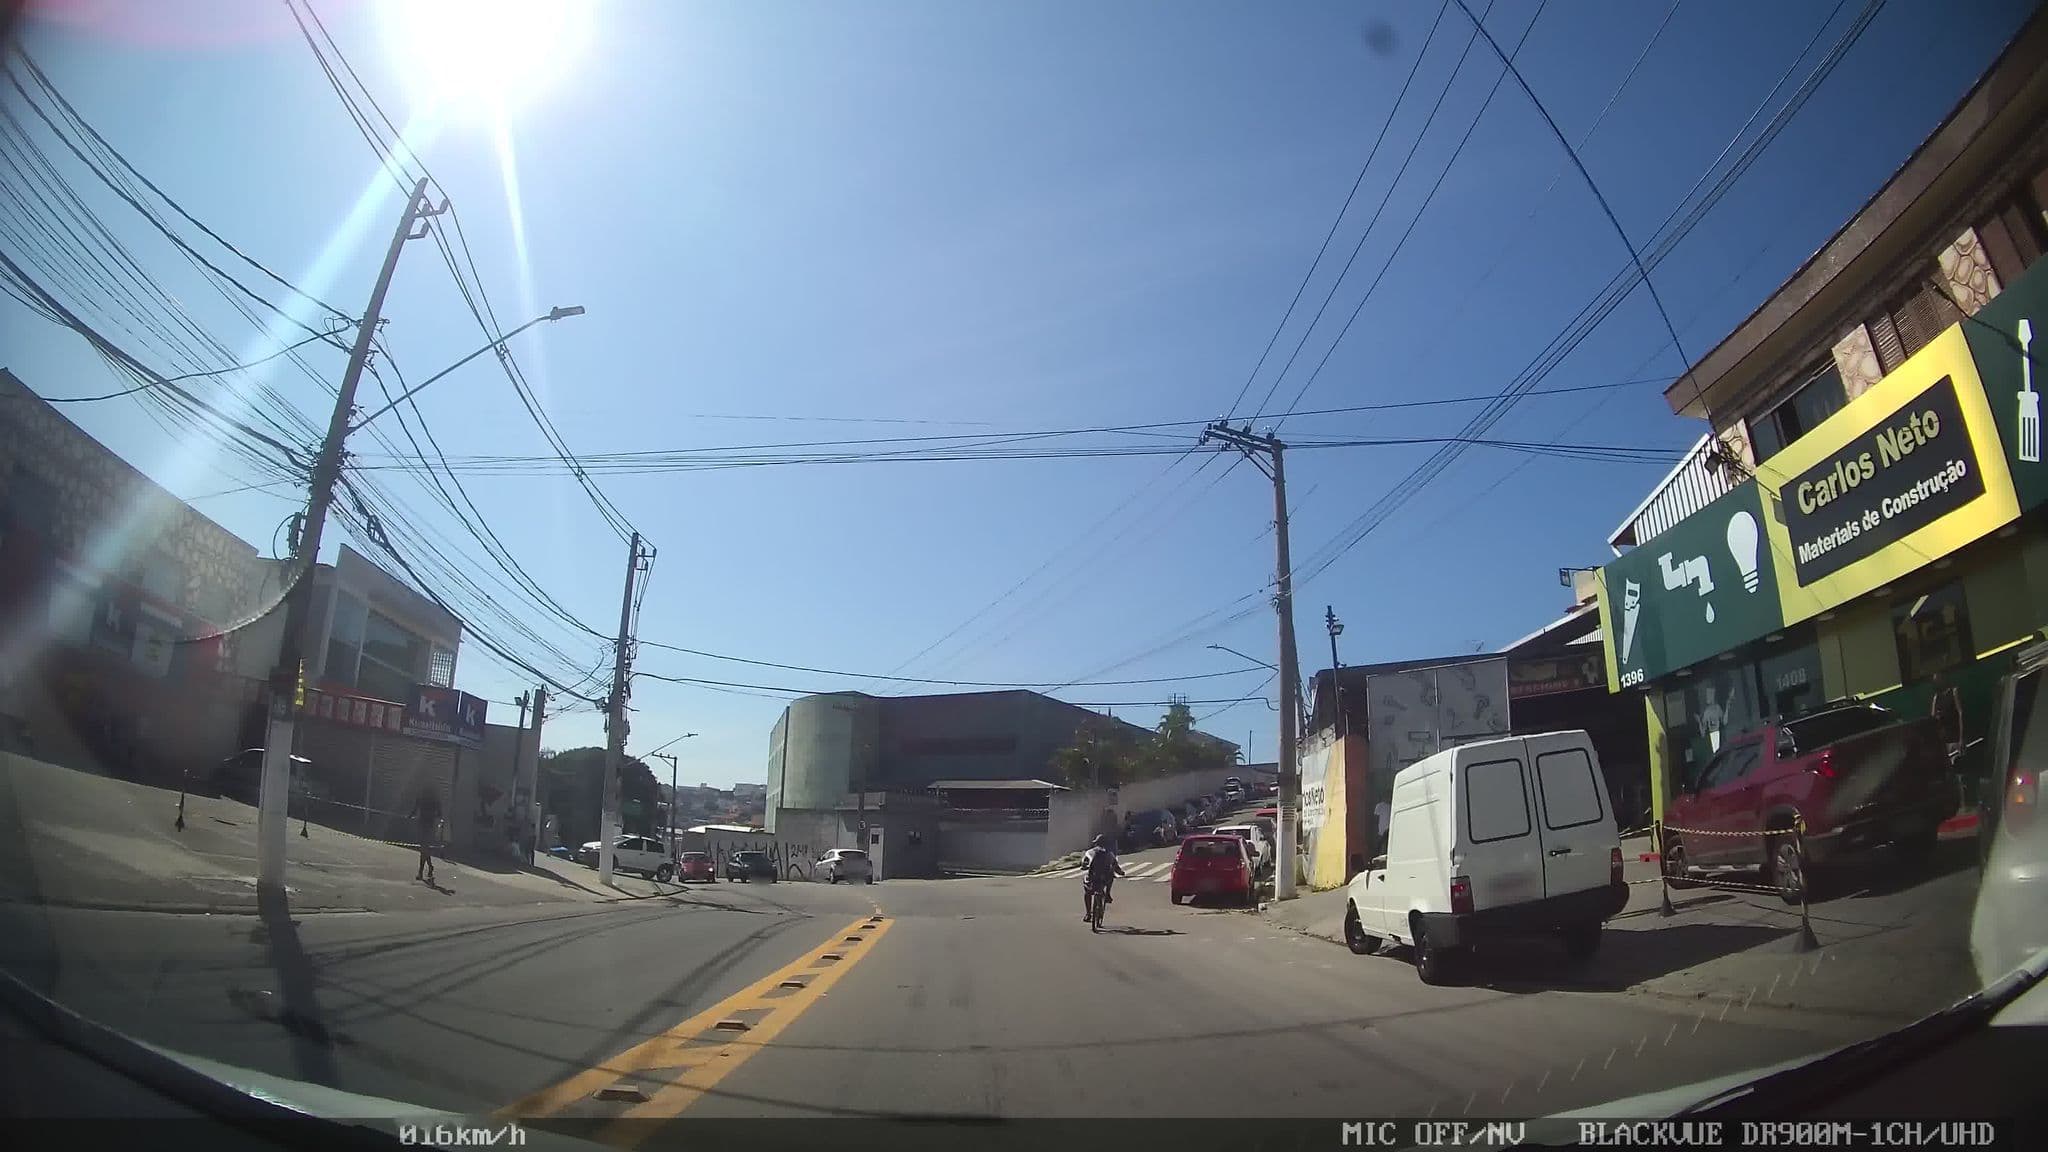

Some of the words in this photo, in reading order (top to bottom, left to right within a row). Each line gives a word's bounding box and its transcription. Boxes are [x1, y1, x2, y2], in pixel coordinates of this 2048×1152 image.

[1798, 452, 1875, 515] Carlos
[1876, 410, 1941, 468] Neto
[1799, 519, 1861, 564] Materiais
[1862, 509, 1880, 531] de
[1881, 459, 1967, 519] Construção
[1620, 668, 1644, 688] 1396
